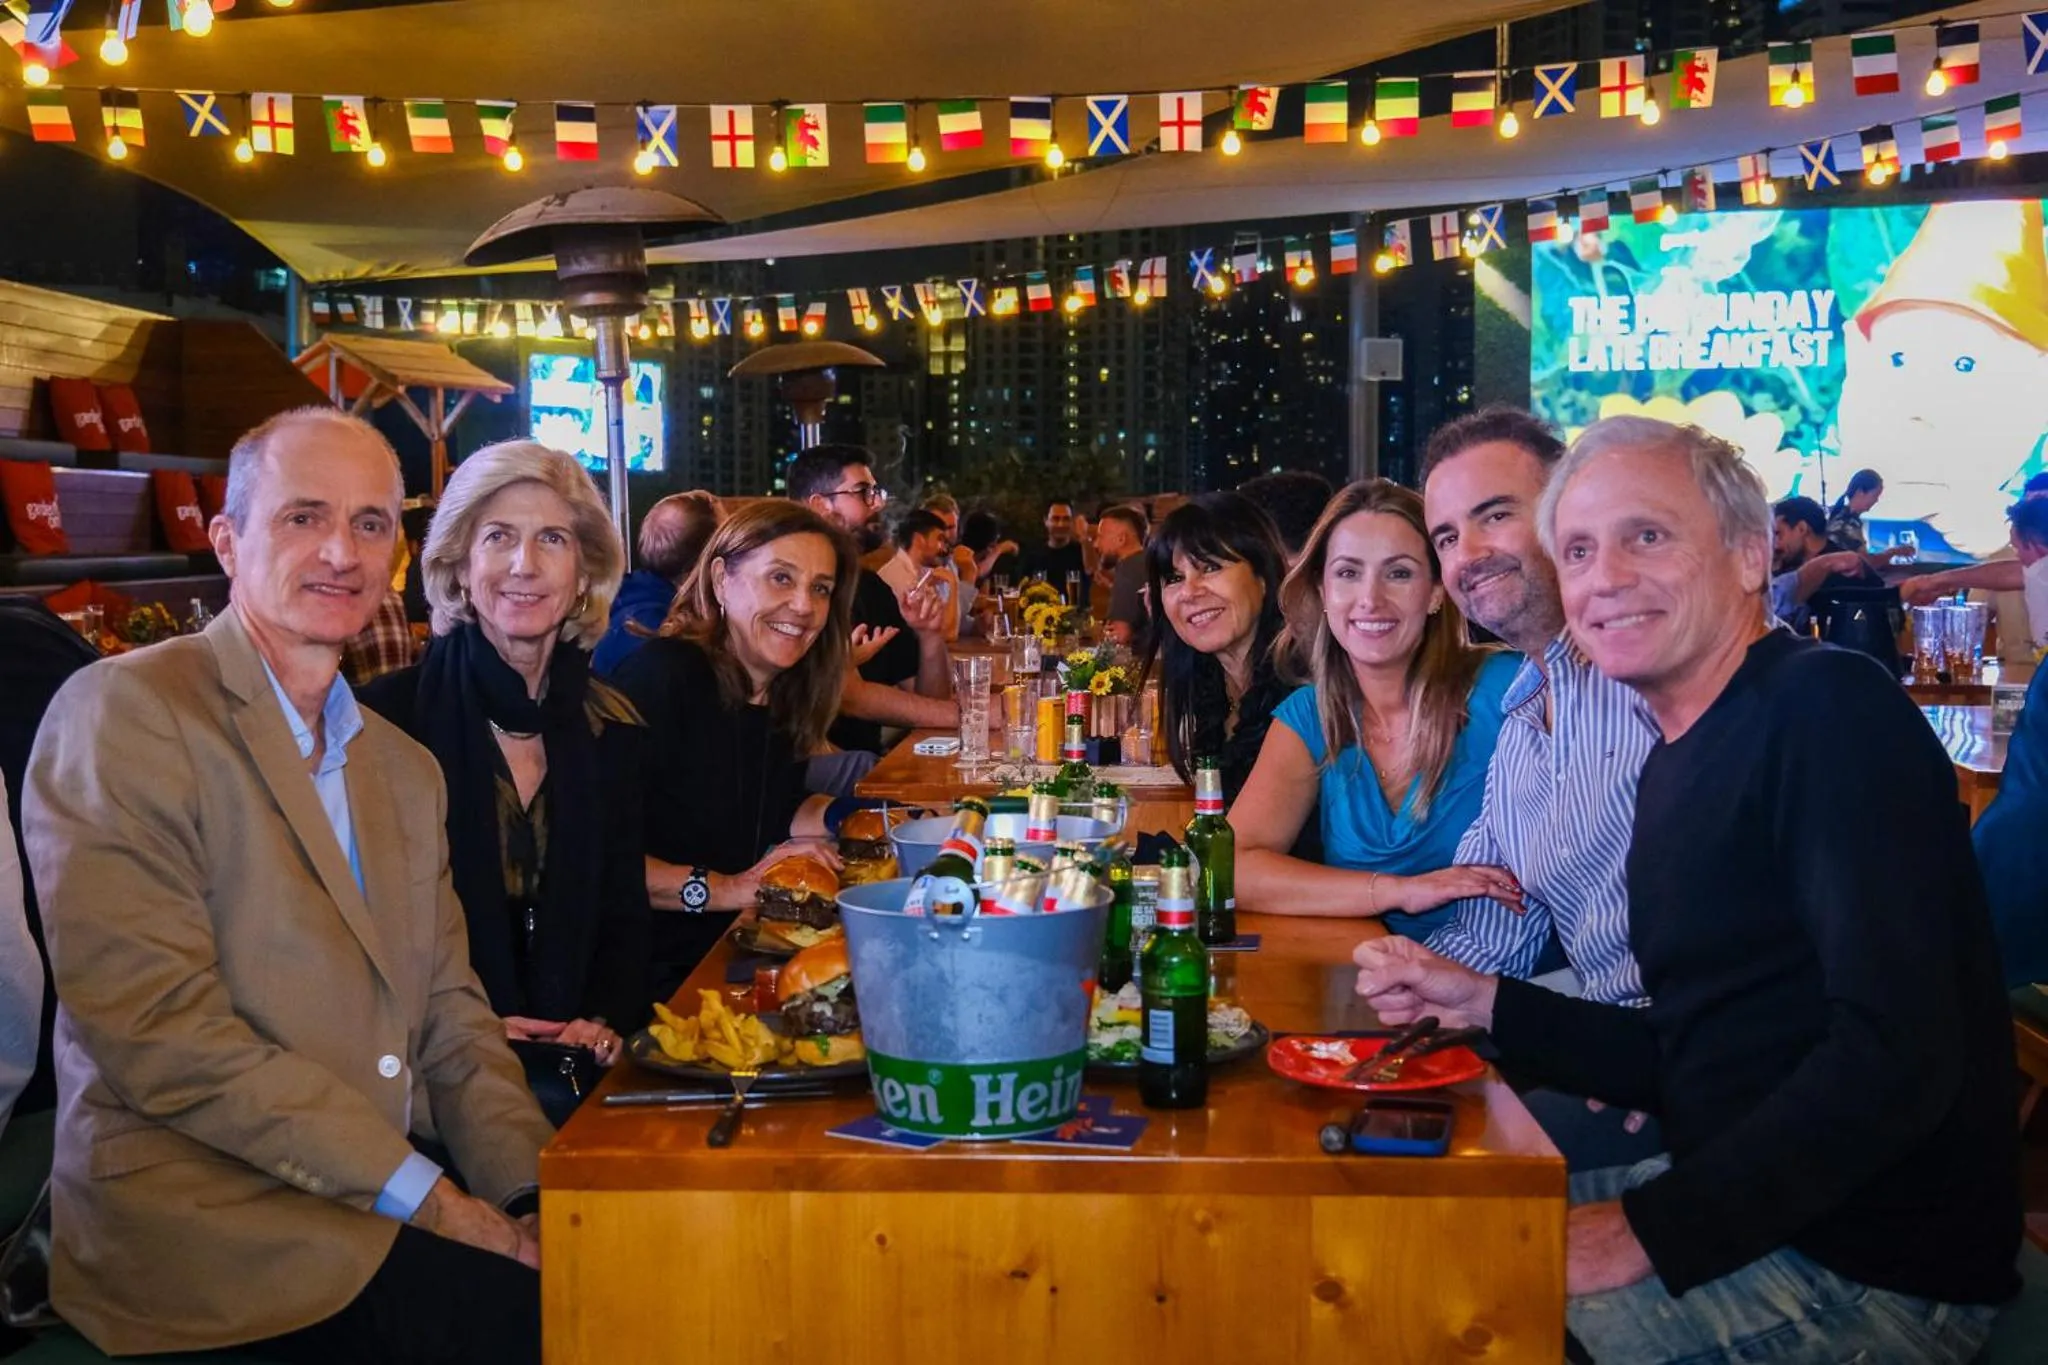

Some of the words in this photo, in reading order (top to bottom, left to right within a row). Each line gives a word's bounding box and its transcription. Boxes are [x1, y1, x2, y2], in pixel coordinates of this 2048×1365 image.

[1568, 296, 1630, 334] THE
[1569, 334, 1646, 372] LATE
[1649, 331, 1834, 369] BREAKFAST
